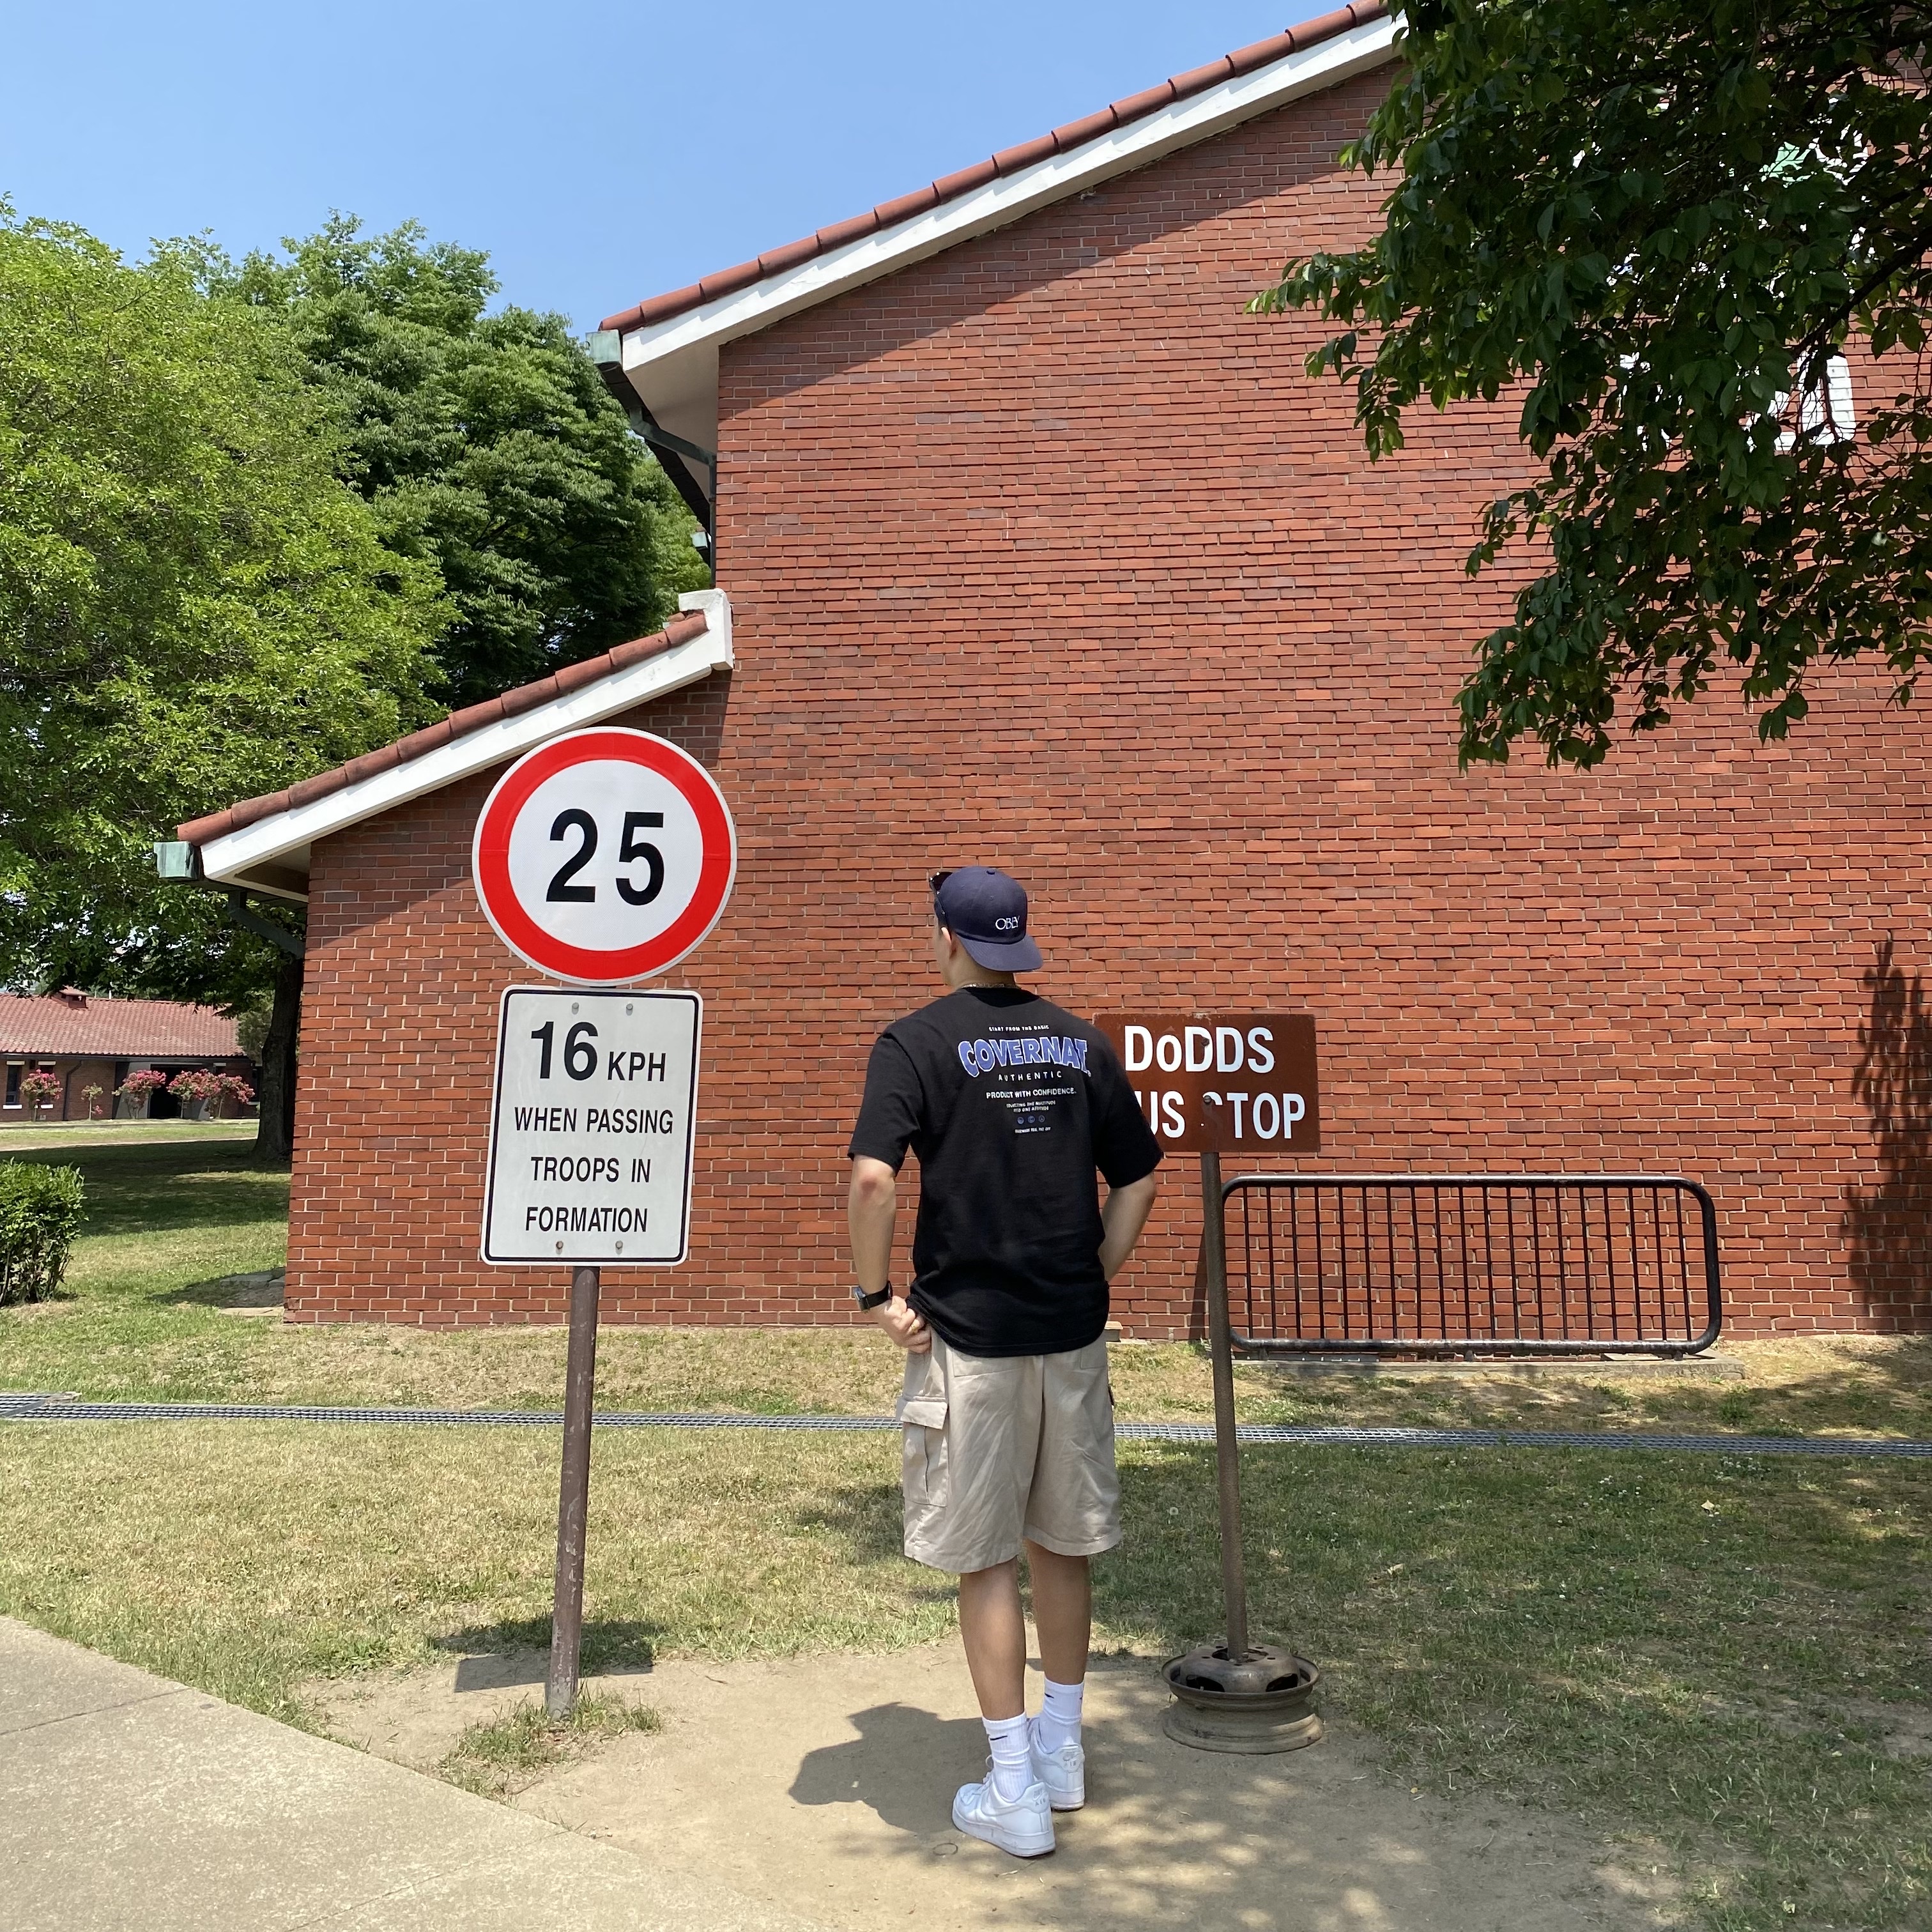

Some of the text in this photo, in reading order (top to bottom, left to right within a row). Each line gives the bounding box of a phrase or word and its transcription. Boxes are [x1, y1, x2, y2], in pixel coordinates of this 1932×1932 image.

[546, 808, 664, 906] 25
[995, 916, 1020, 930] OBEY
[531, 1021, 666, 1082] 16 KPH
[958, 1036, 1088, 1078] COVERNAT
[1124, 1025, 1275, 1073] DoDDS
[998, 1071, 1062, 1082] AUTHENTIC
[1015, 1090, 1031, 1098] WITH
[514, 1107, 674, 1134] WHEN PASSING
[1134, 1091, 1185, 1138] US
[531, 1156, 651, 1183] TROOPS IN
[525, 1206, 648, 1232] FORMATION
